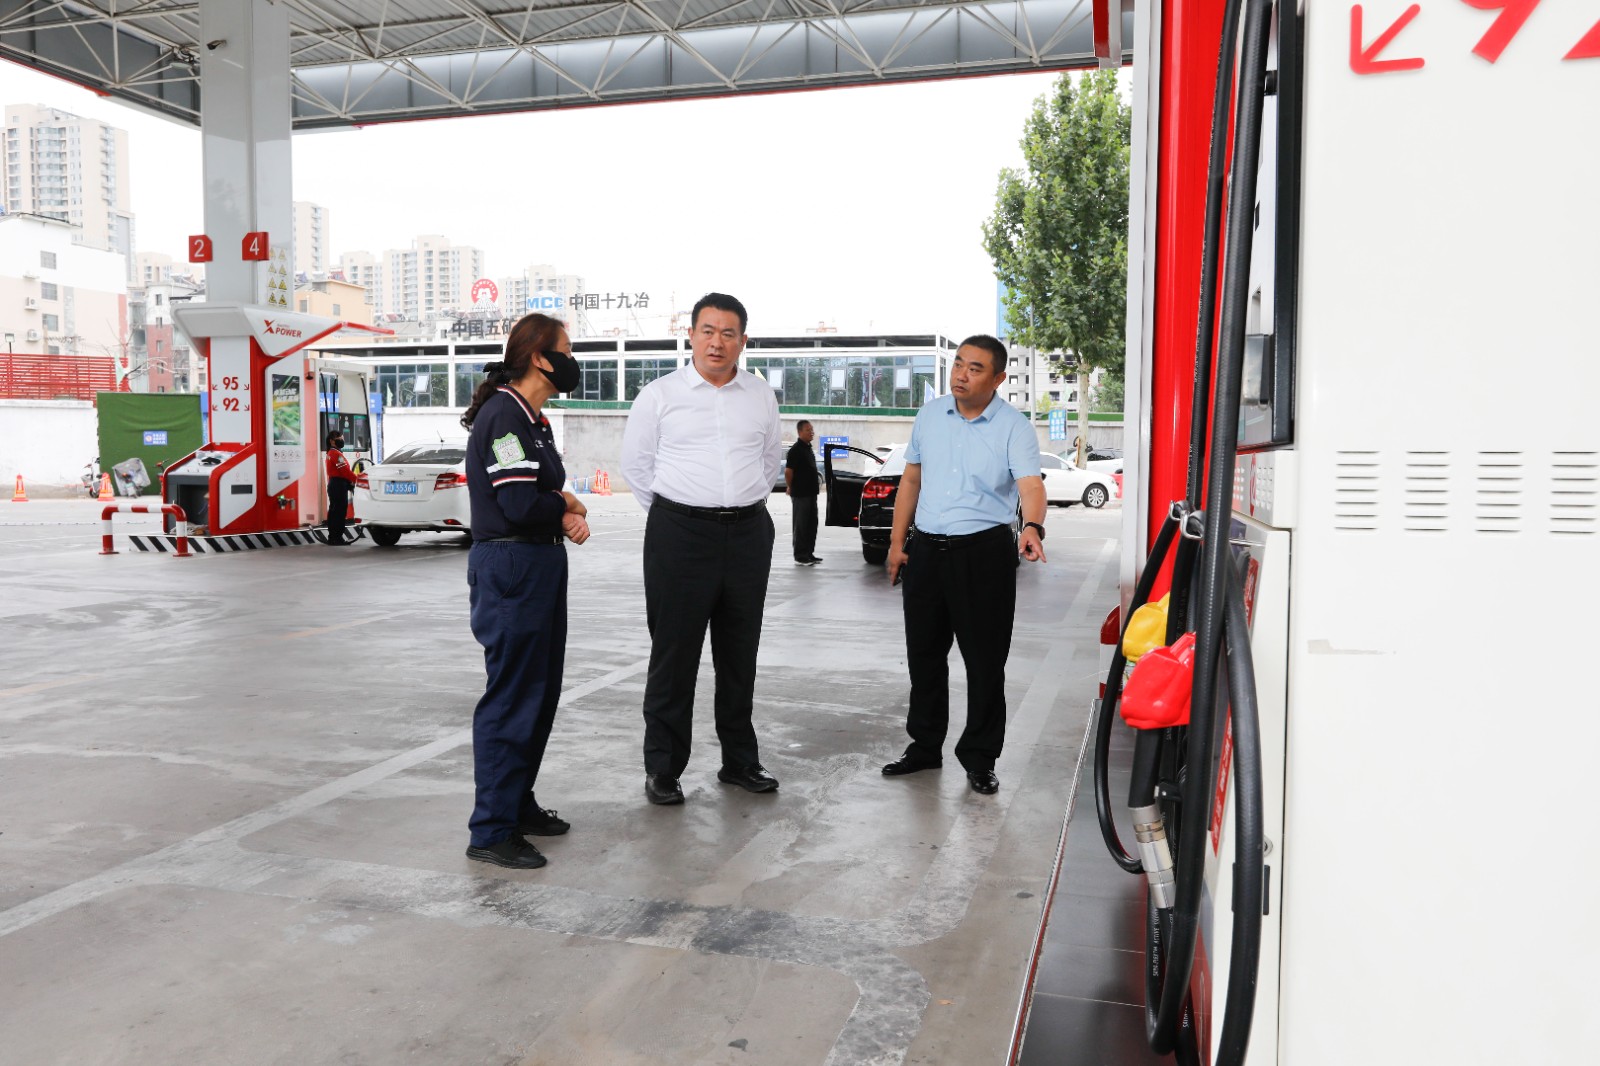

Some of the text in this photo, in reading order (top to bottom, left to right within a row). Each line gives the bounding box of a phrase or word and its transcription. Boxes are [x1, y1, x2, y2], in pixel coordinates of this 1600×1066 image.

[193, 239, 205, 258] 2
[250, 237, 260, 256] 4
[569, 292, 650, 311] 中国十九冶
[275, 327, 303, 338] POWER
[222, 376, 240, 391] 95
[222, 398, 240, 412] 92
